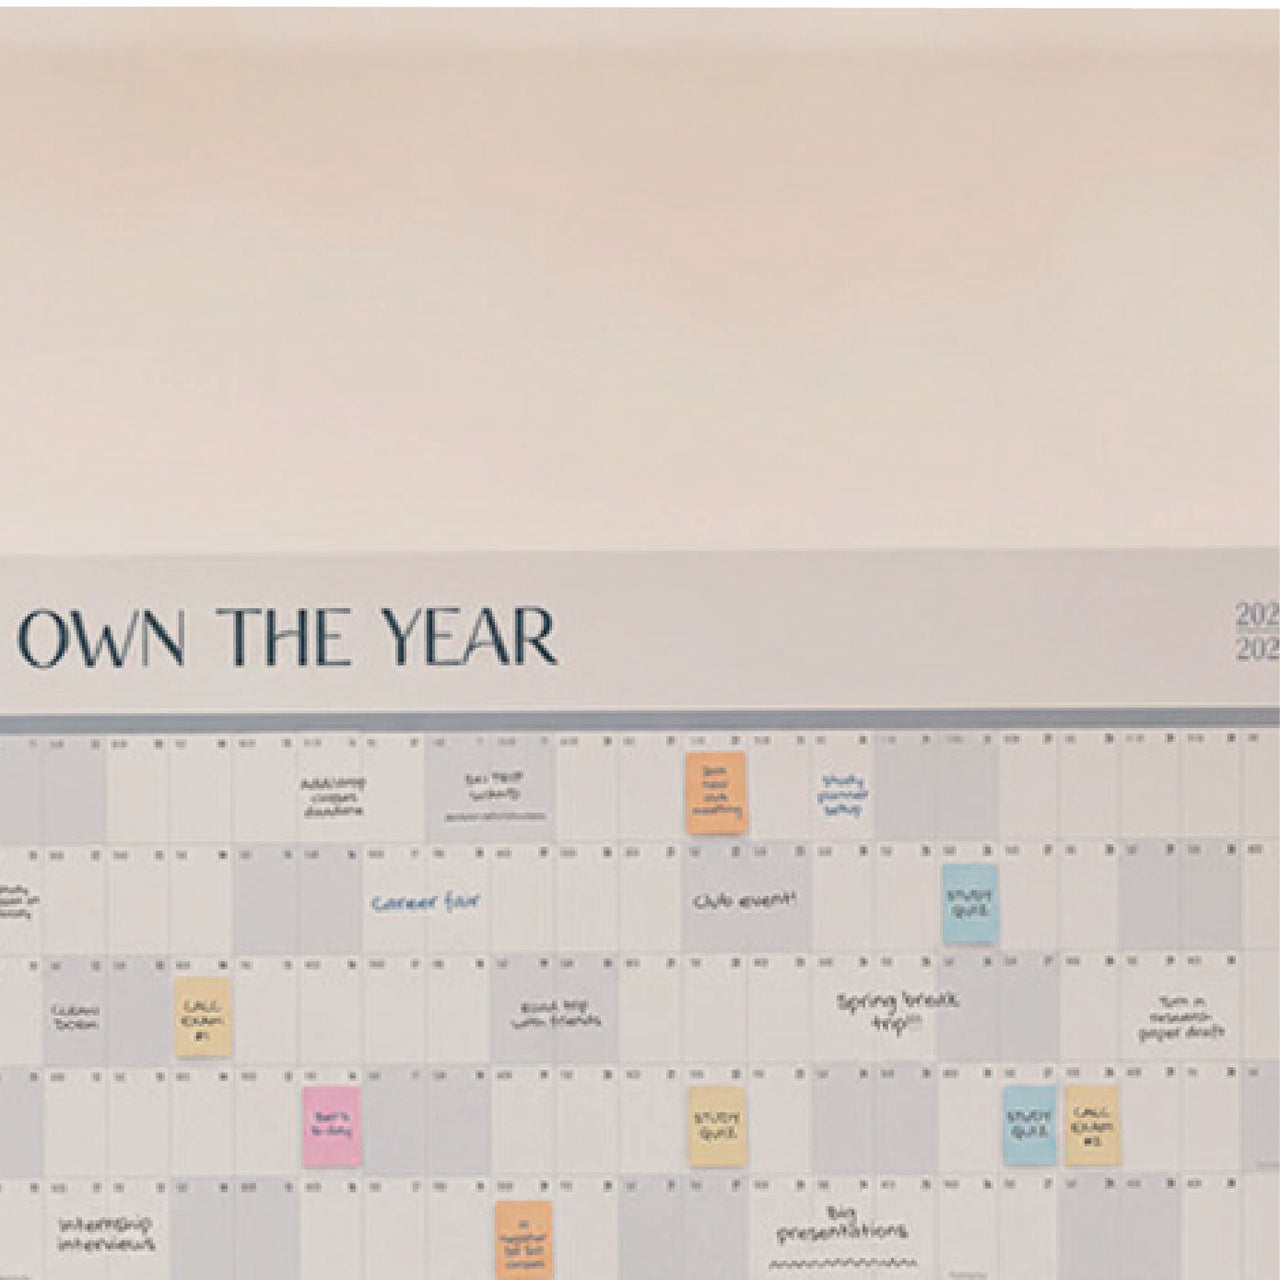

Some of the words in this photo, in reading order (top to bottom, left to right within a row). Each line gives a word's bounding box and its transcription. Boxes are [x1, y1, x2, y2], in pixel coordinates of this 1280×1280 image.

[1235, 600, 1280, 626] 202
[17, 607, 186, 669] OWN
[216, 607, 351, 667] THE
[380, 606, 558, 667] YEAR
[1235, 637, 1280, 662] 202
[777, 1224, 909, 1243] presentations
